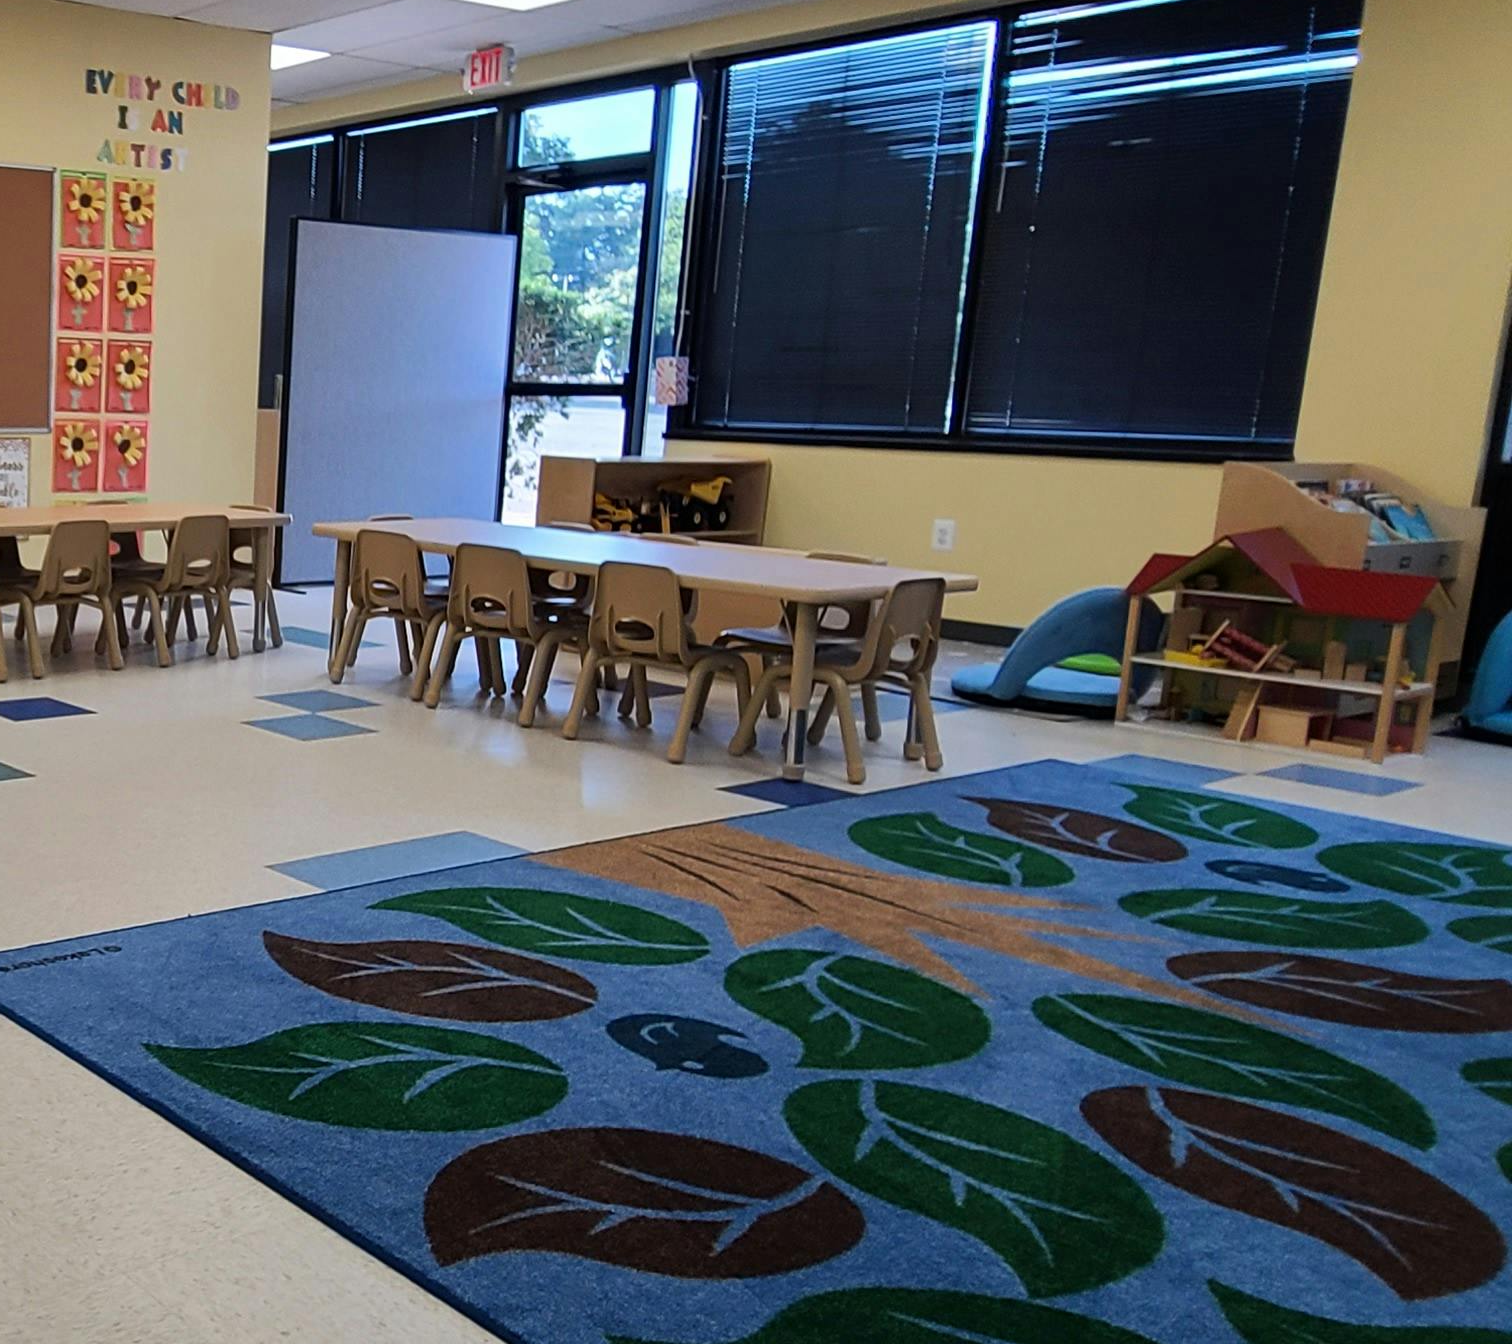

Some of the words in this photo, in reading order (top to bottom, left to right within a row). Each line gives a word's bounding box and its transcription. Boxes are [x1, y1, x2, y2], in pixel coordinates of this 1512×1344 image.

[470, 48, 502, 87] EXIT
[85, 69, 161, 101] EVERY
[172, 81, 240, 110] CHILD
[118, 105, 139, 132] IS
[151, 109, 183, 135] AN
[97, 139, 188, 172] ARTIST
